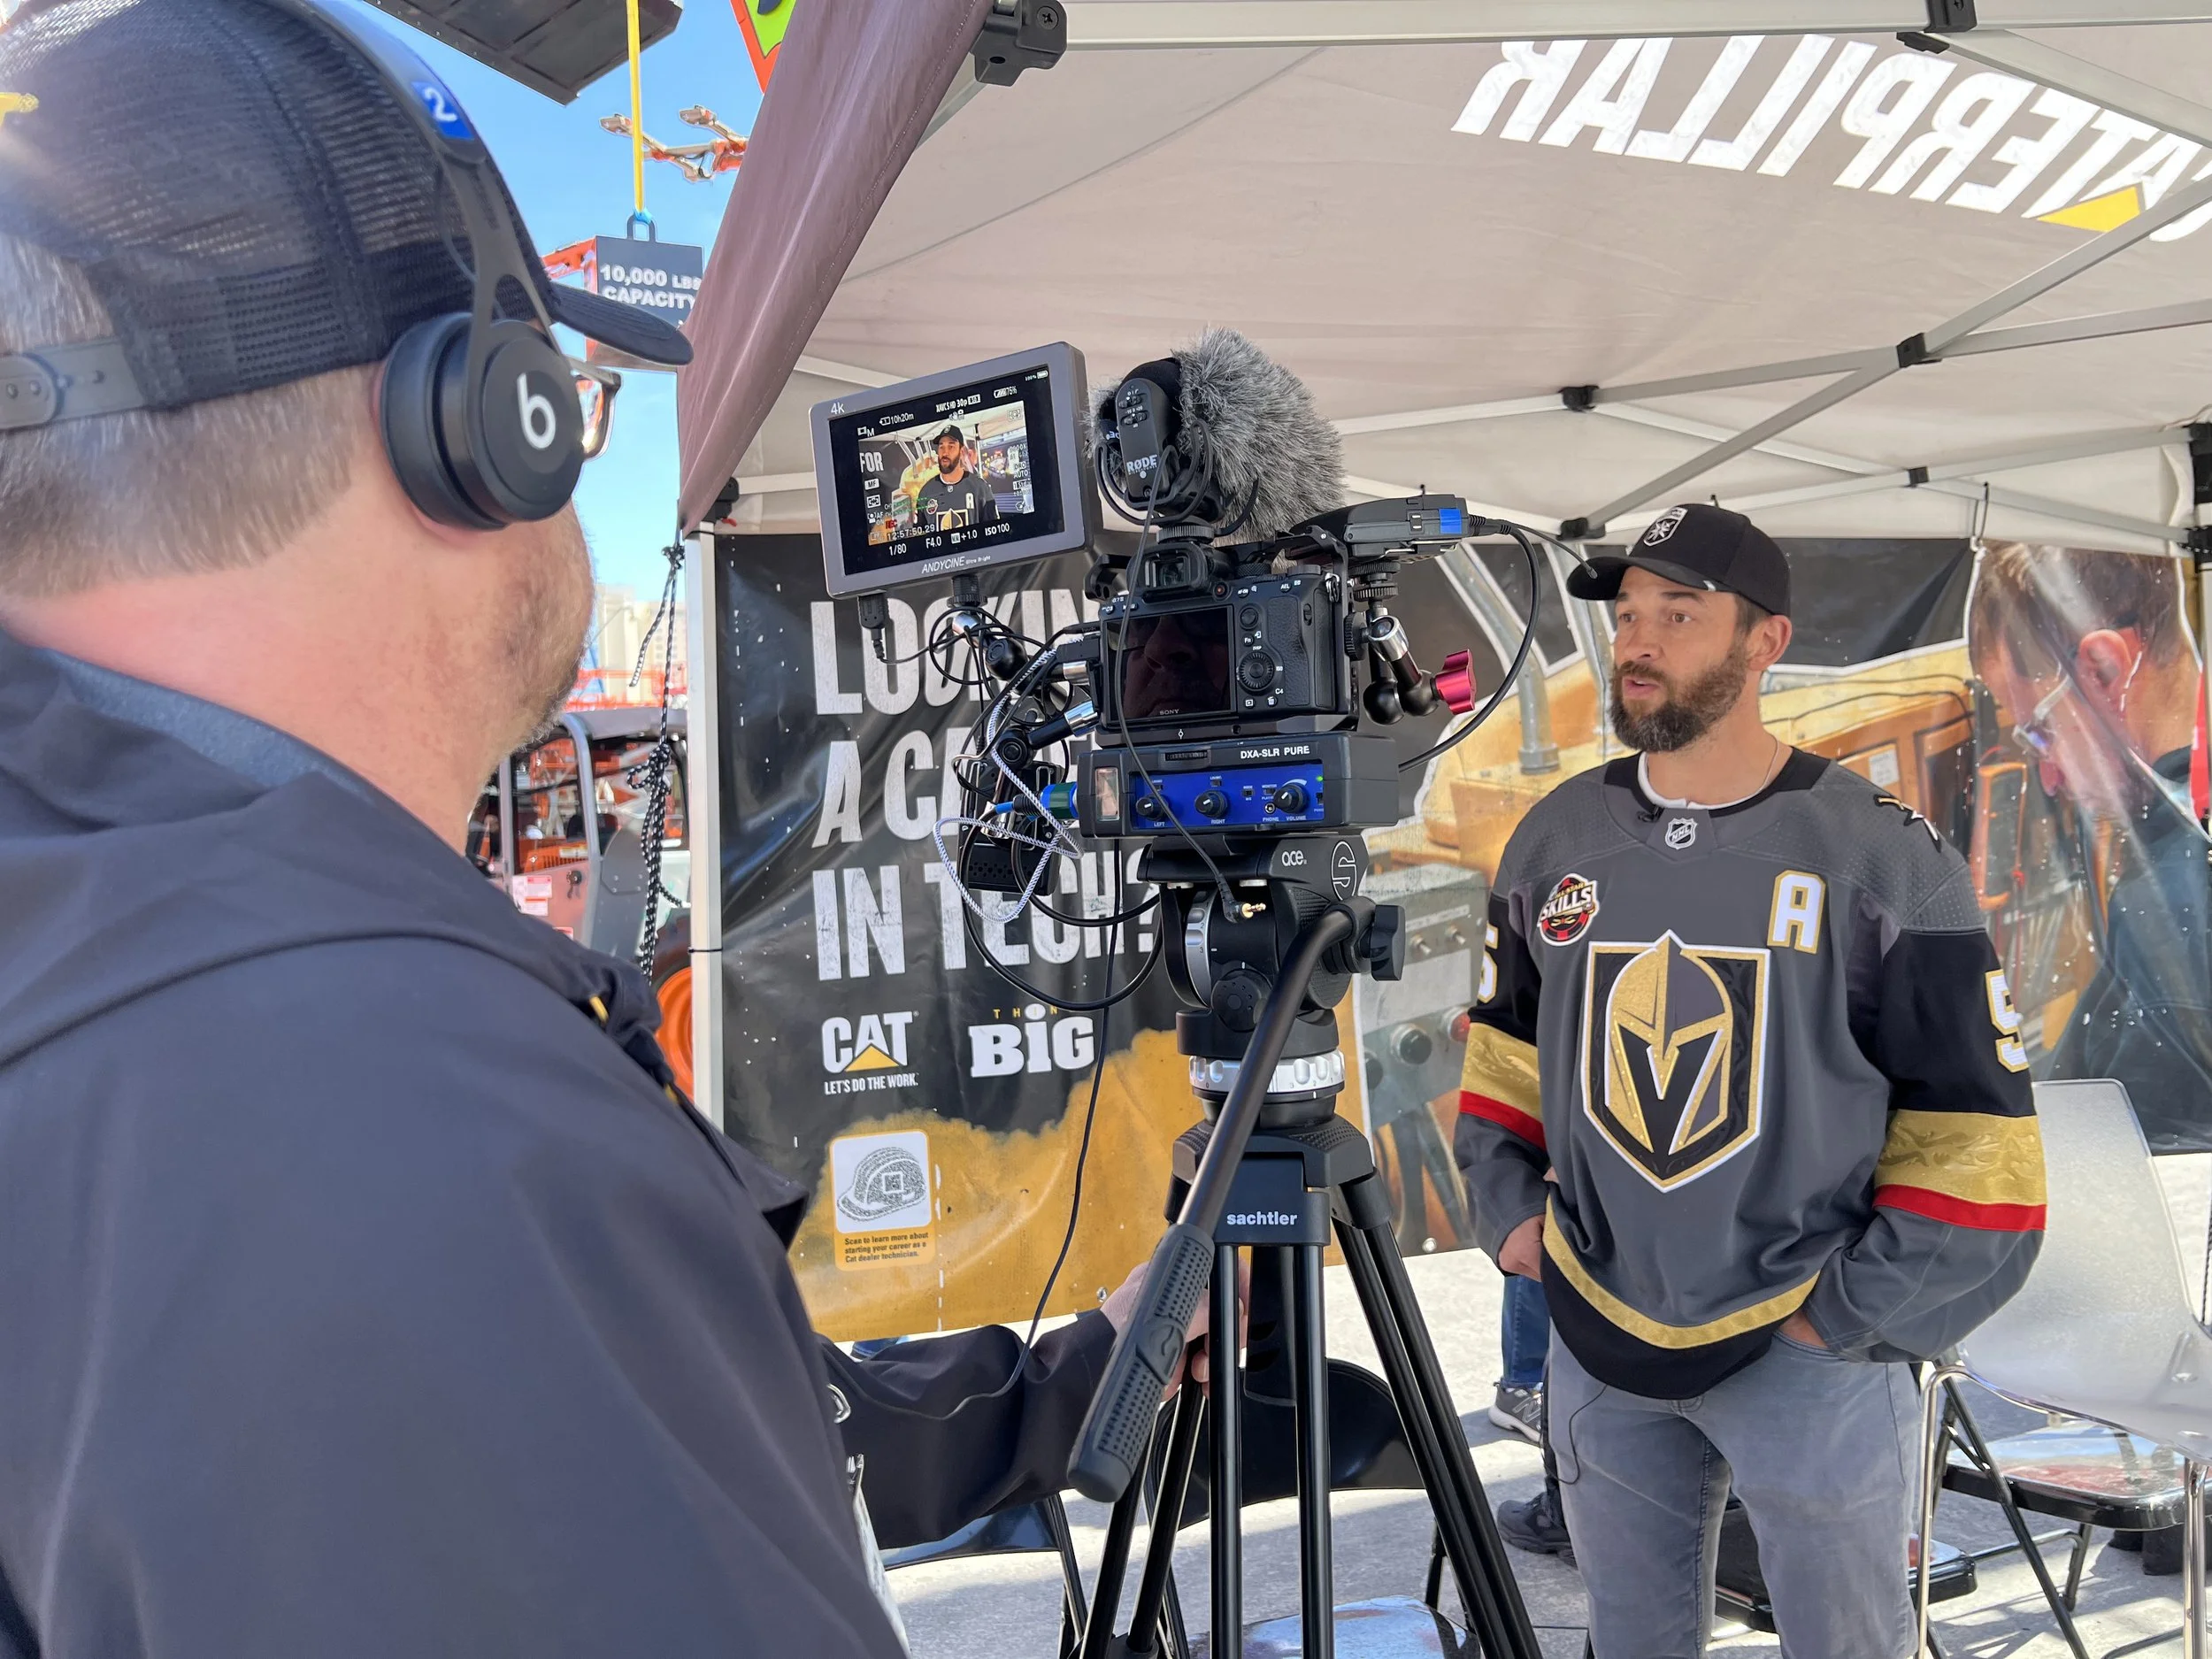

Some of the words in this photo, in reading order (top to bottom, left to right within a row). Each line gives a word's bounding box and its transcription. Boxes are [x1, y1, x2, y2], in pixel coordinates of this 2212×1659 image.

[424, 88, 457, 122] 2
[600, 264, 668, 287] 10,000
[831, 402, 845, 415] 4K
[956, 398, 968, 408] 30p
[890, 412, 914, 425] 10h20m
[859, 451, 884, 473] FOR
[1126, 454, 1158, 472] RØDE
[888, 543, 907, 557] 1/80
[926, 536, 942, 549] F4.0
[921, 556, 965, 574] ANDYCINE
[1240, 748, 1280, 759] DXA-SLR
[1284, 745, 1310, 756] PURE
[811, 740, 864, 849] A
[1281, 849, 1303, 866] ace
[1540, 886, 1593, 922] SKILLS
[1768, 869, 1827, 955] A
[812, 864, 906, 981] IN
[821, 1010, 913, 1074] CAT
[824, 1079, 851, 1096] LET'S
[852, 1077, 866, 1093] DO
[867, 1075, 887, 1091] THE
[1226, 1210, 1298, 1225] sachtler
[845, 1237, 863, 1246] Scan
[910, 1232, 929, 1240] about
[845, 1245, 872, 1255] starting
[872, 1244, 887, 1254] your
[858, 1253, 880, 1262] dealer
